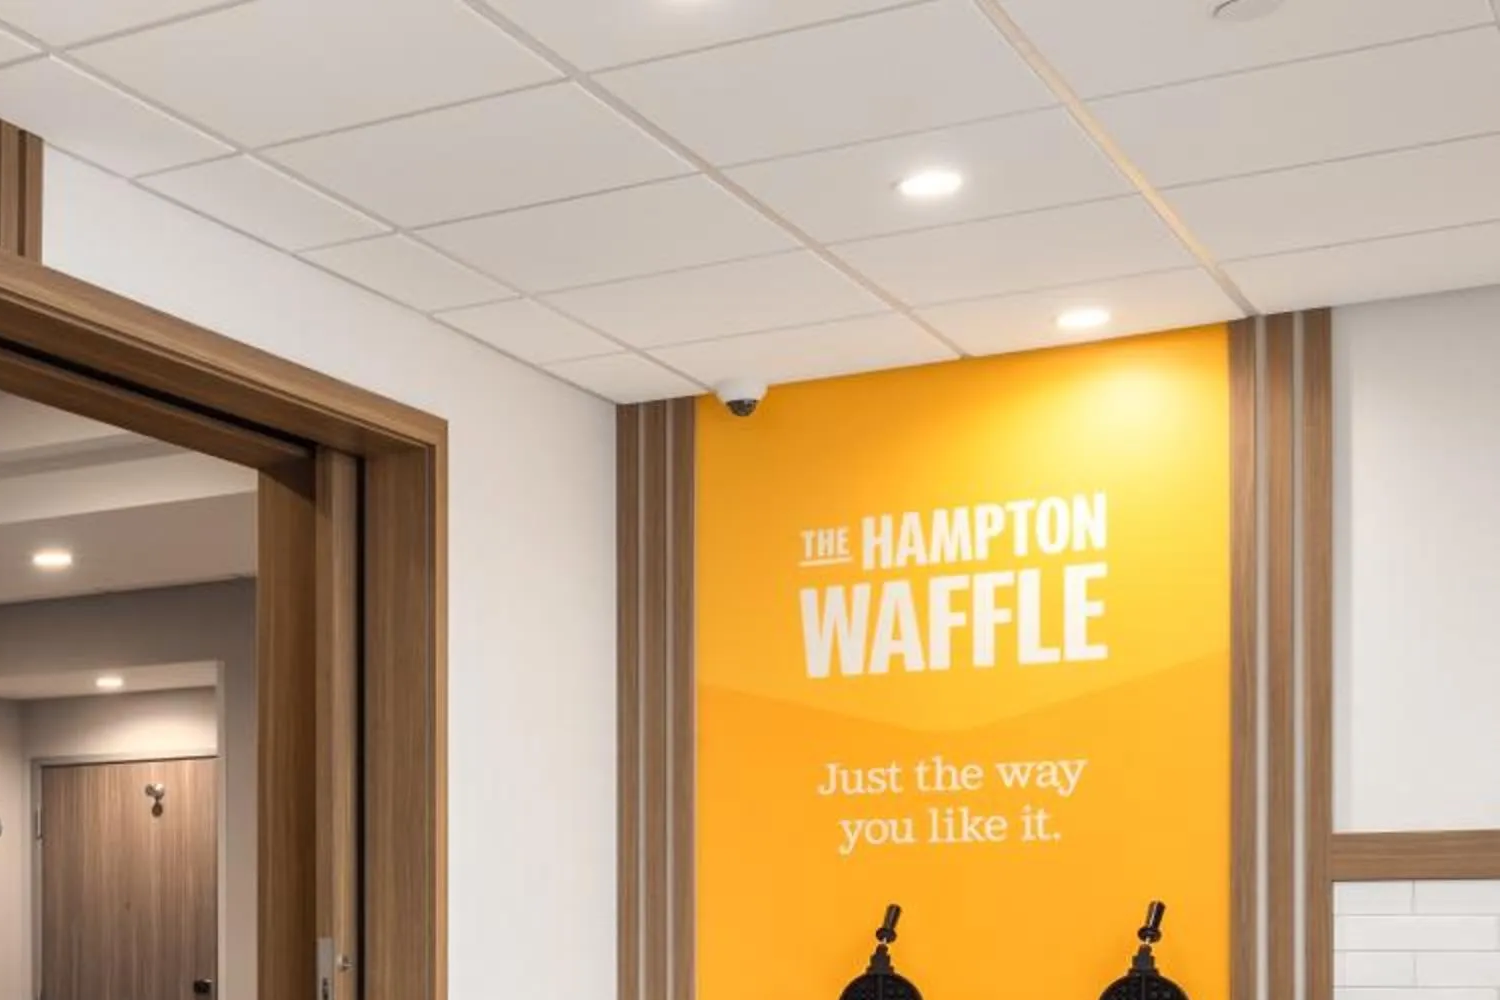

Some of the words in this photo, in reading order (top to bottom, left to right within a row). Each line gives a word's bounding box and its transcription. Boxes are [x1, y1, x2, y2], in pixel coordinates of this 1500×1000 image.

[801, 526, 850, 558] THE
[861, 492, 1107, 571] HAMPTON
[800, 562, 1108, 678] WAFFLE
[817, 760, 904, 795] Just
[914, 755, 984, 791] the
[996, 758, 1088, 797] way
[838, 815, 915, 855] you
[928, 806, 1007, 844] like
[1021, 803, 1061, 842] it.
